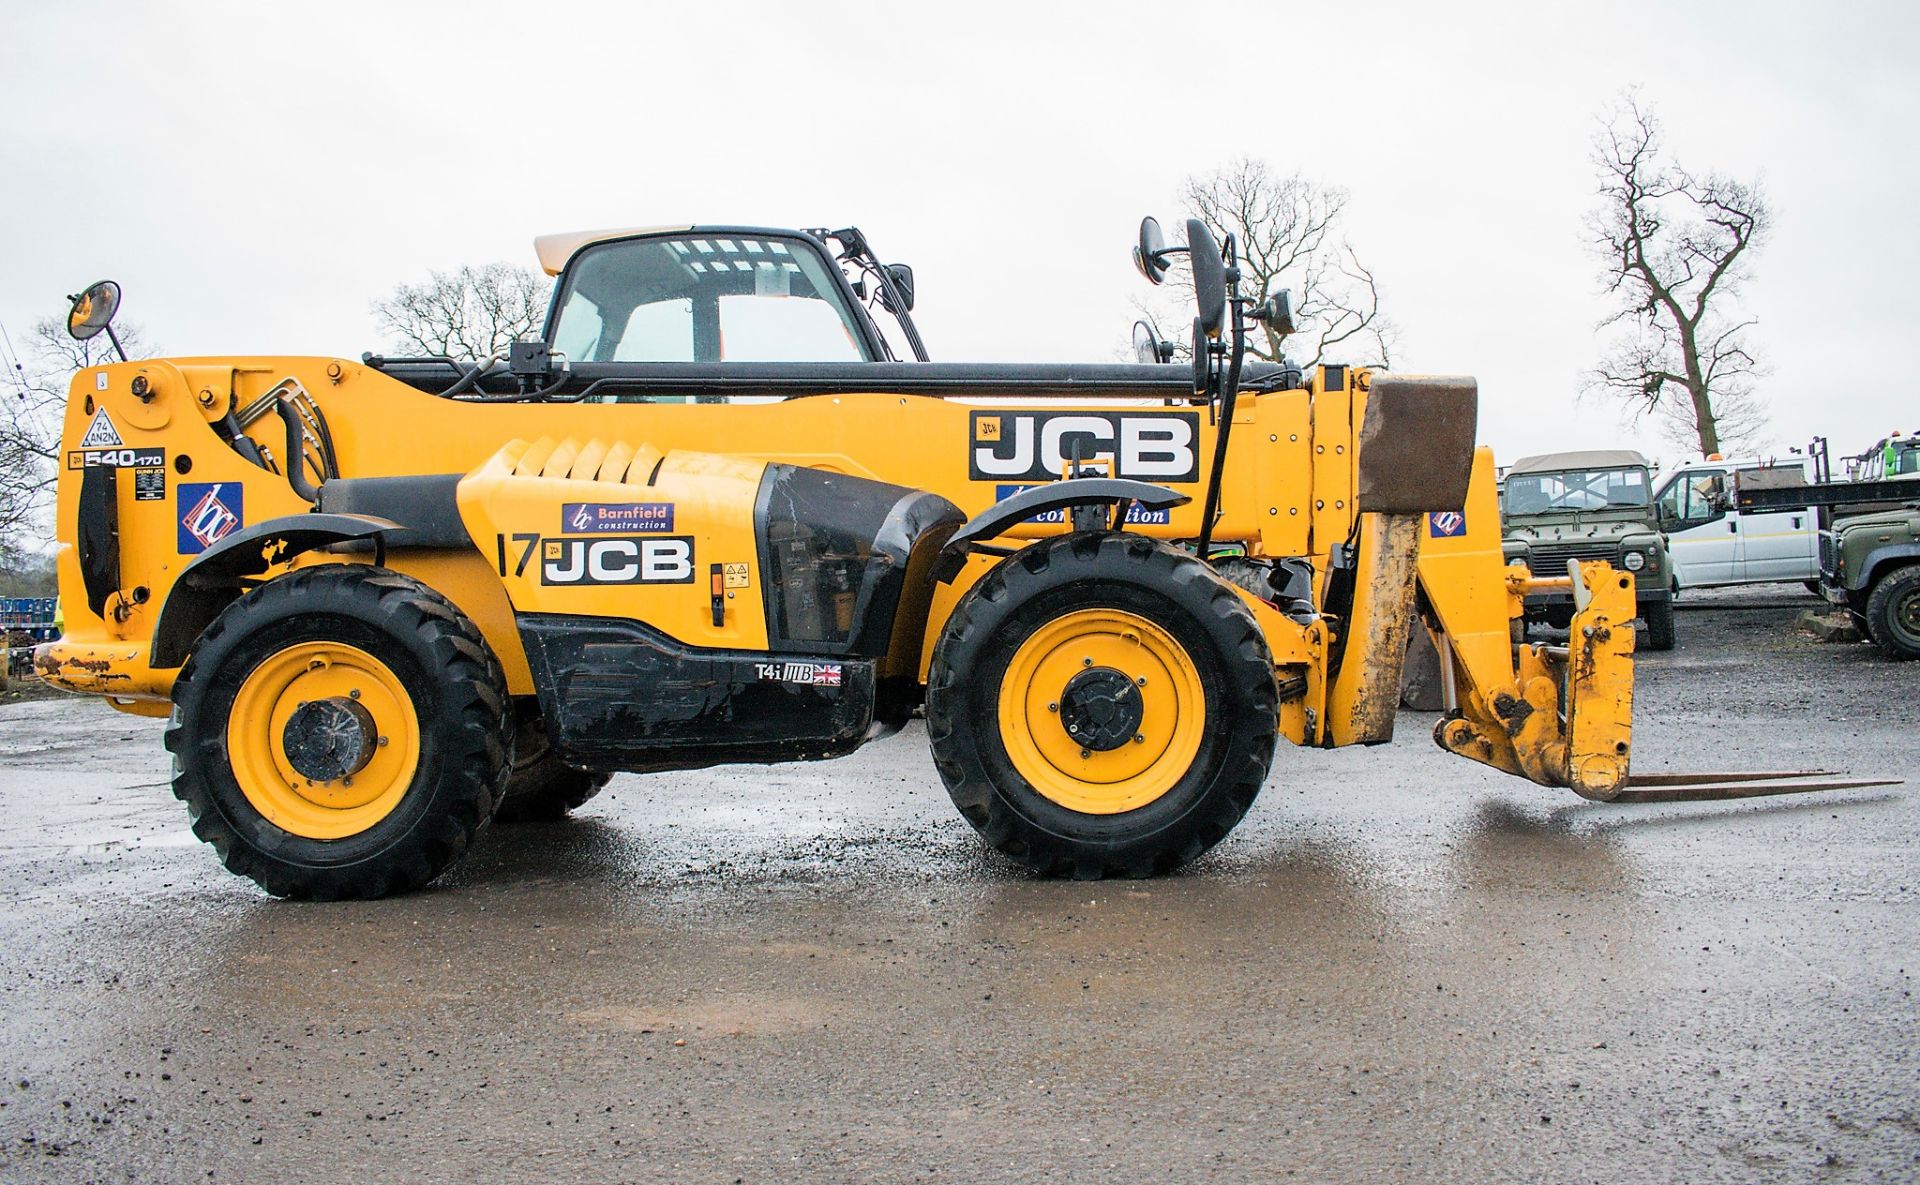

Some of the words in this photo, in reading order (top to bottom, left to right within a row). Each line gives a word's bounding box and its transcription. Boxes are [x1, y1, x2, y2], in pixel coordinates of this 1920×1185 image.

[96, 423, 107, 431] 74
[91, 433, 114, 442] AN2N
[976, 416, 1194, 475] JCB
[598, 507, 667, 519] Barnfield
[1036, 509, 1165, 522] cotion
[598, 521, 666, 530] construction
[497, 533, 541, 578] 17
[545, 540, 692, 582] JCB
